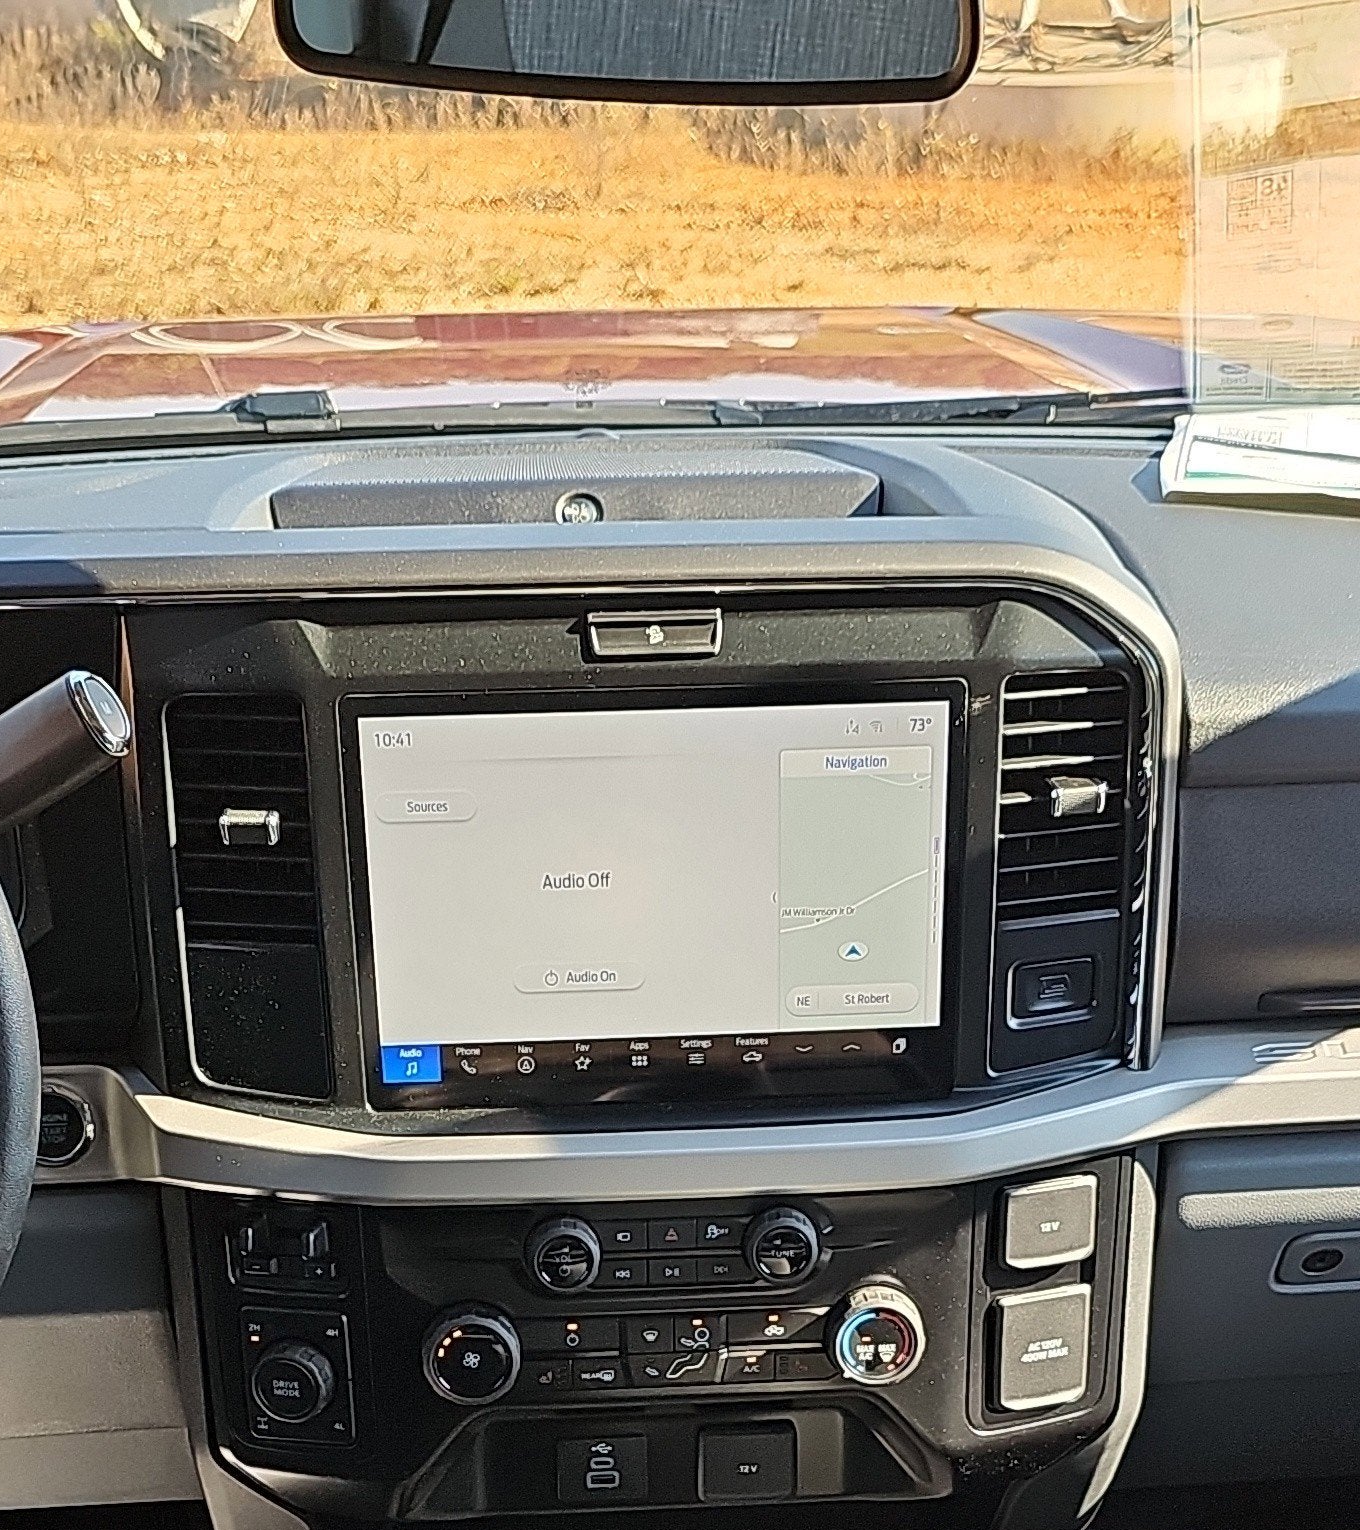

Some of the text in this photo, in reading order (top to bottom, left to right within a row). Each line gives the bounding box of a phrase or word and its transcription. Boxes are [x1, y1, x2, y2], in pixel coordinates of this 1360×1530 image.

[909, 718, 932, 732] 73°
[374, 732, 412, 747] 10:41
[825, 755, 887, 770] Navigation
[407, 801, 448, 813] Sources
[542, 872, 611, 889] Audio Off
[846, 907, 855, 915] Dr
[566, 970, 616, 983] Audio On
[796, 996, 811, 1006] NE
[845, 993, 889, 1004] St Robert
[630, 1041, 649, 1051] Apps
[680, 1039, 712, 1049] Settings
[735, 1037, 769, 1046] Features
[455, 1047, 480, 1056] Phone
[518, 1044, 533, 1053] Nav
[576, 1043, 590, 1052] Fav
[399, 1048, 422, 1058] Audio
[326, 1329, 339, 1337] 4H
[743, 1365, 760, 1373] A/C
[272, 1380, 299, 1389] DRIVE
[273, 1389, 300, 1397] MODE
